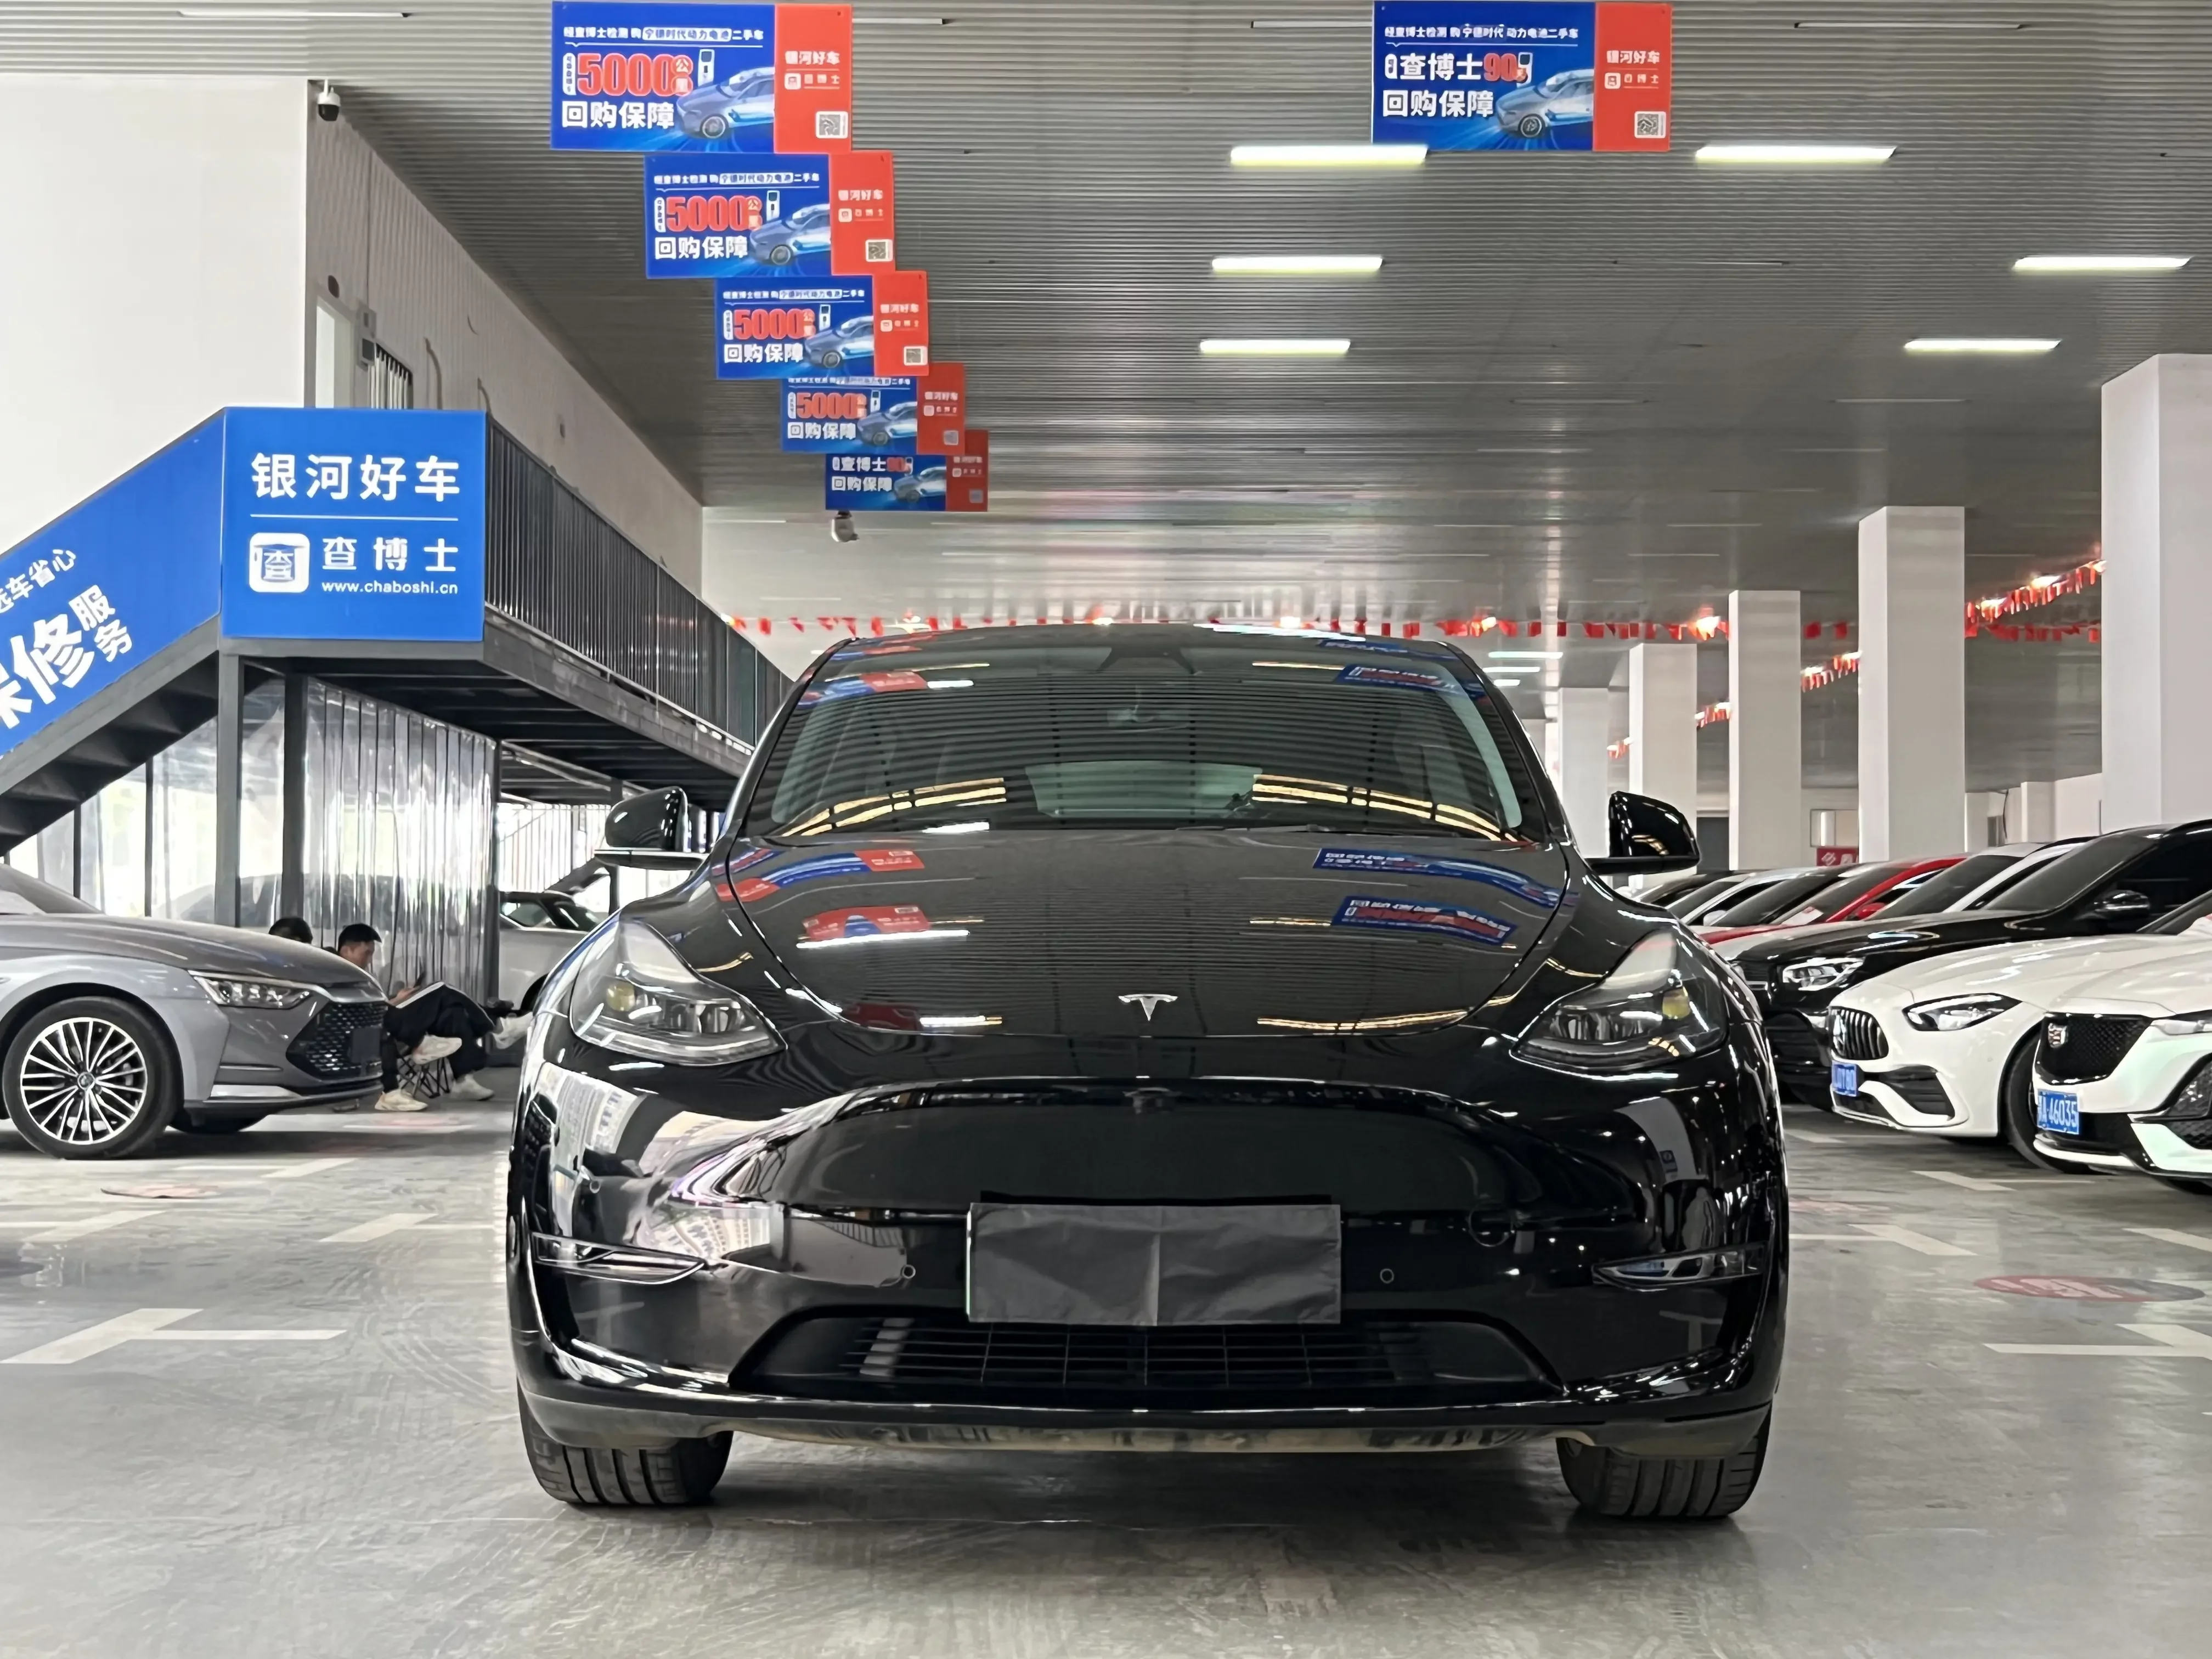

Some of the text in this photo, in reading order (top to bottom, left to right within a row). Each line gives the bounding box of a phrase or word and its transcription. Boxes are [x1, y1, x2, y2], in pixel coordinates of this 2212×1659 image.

[562, 101, 675, 129] 回购保障
[1383, 90, 1493, 117] 回购保障
[655, 236, 748, 259] 回购保障
[724, 342, 804, 363] 回购保障
[251, 453, 460, 501] 银河好车
[322, 537, 459, 572] 查博士
[321, 580, 458, 595] www.chaboshi.cn
